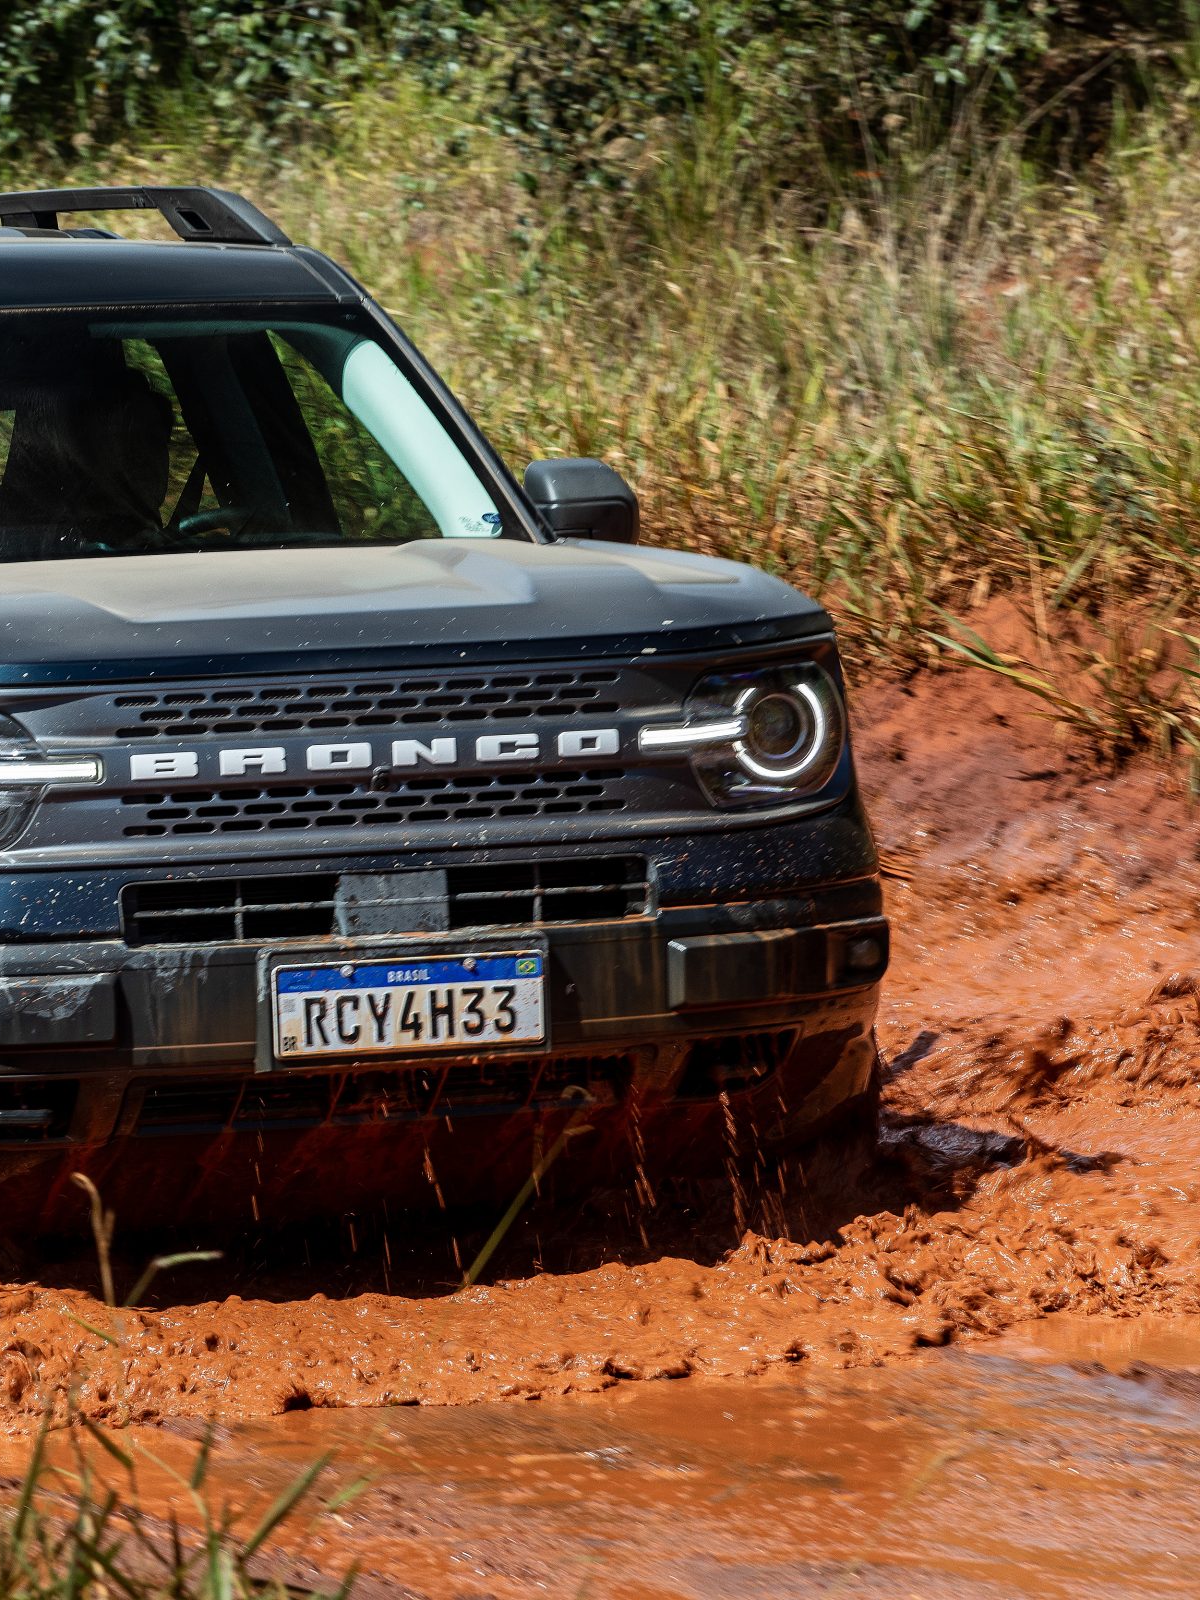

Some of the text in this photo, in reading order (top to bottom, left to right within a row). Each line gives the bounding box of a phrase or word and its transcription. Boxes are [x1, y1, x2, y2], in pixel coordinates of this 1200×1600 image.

[130, 728, 620, 781] BRONCO
[387, 969, 431, 983] BRASIL
[303, 985, 516, 1046] RCY4H33
